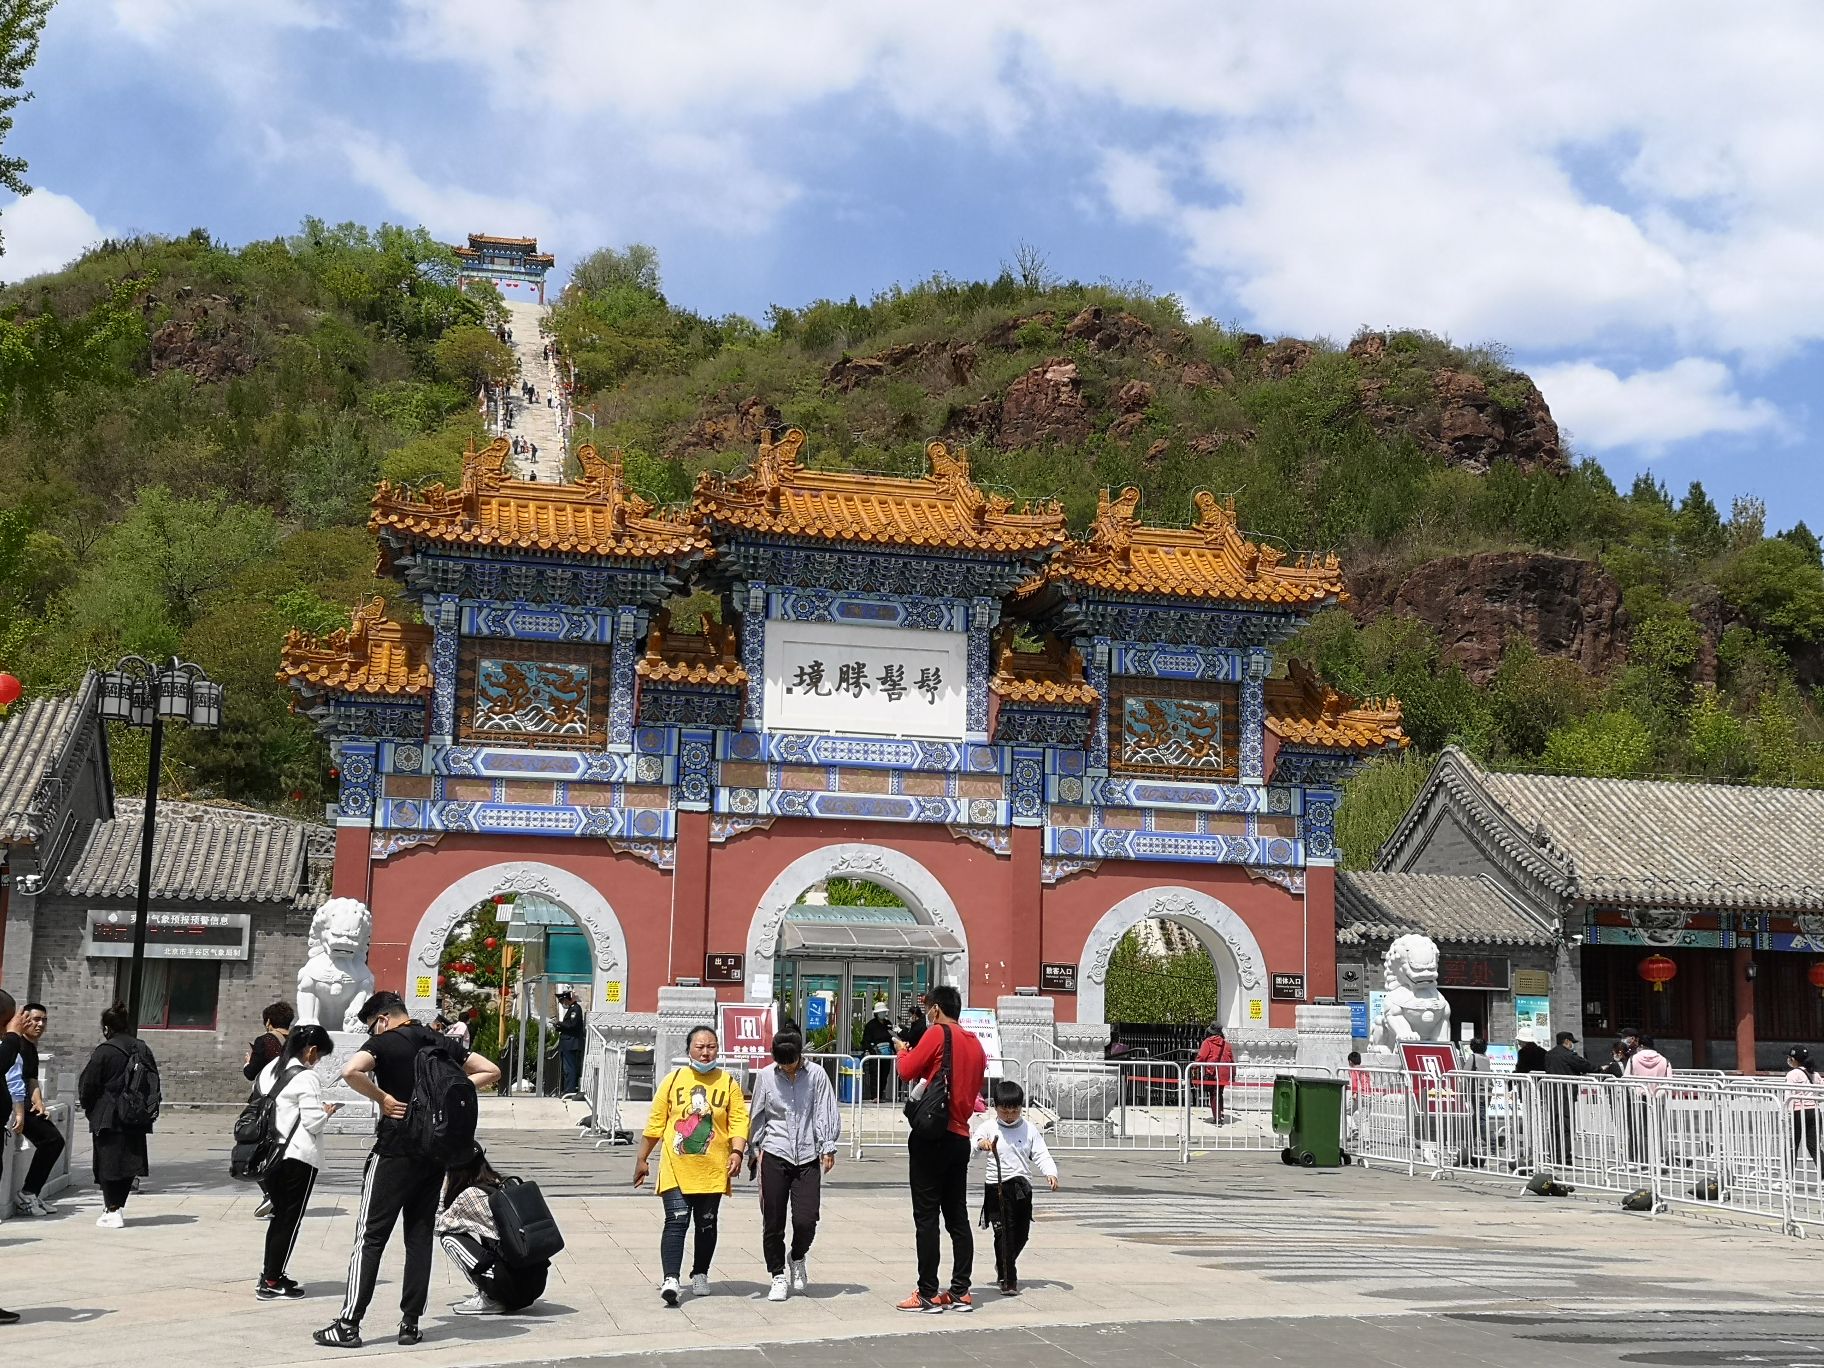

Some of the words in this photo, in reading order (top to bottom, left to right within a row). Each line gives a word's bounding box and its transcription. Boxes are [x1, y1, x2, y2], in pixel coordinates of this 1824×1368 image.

[163, 947, 241, 957] 北京市平谷区气象局制
[1045, 966, 1073, 975] 散客入口
[1275, 976, 1302, 985] 团体入口
